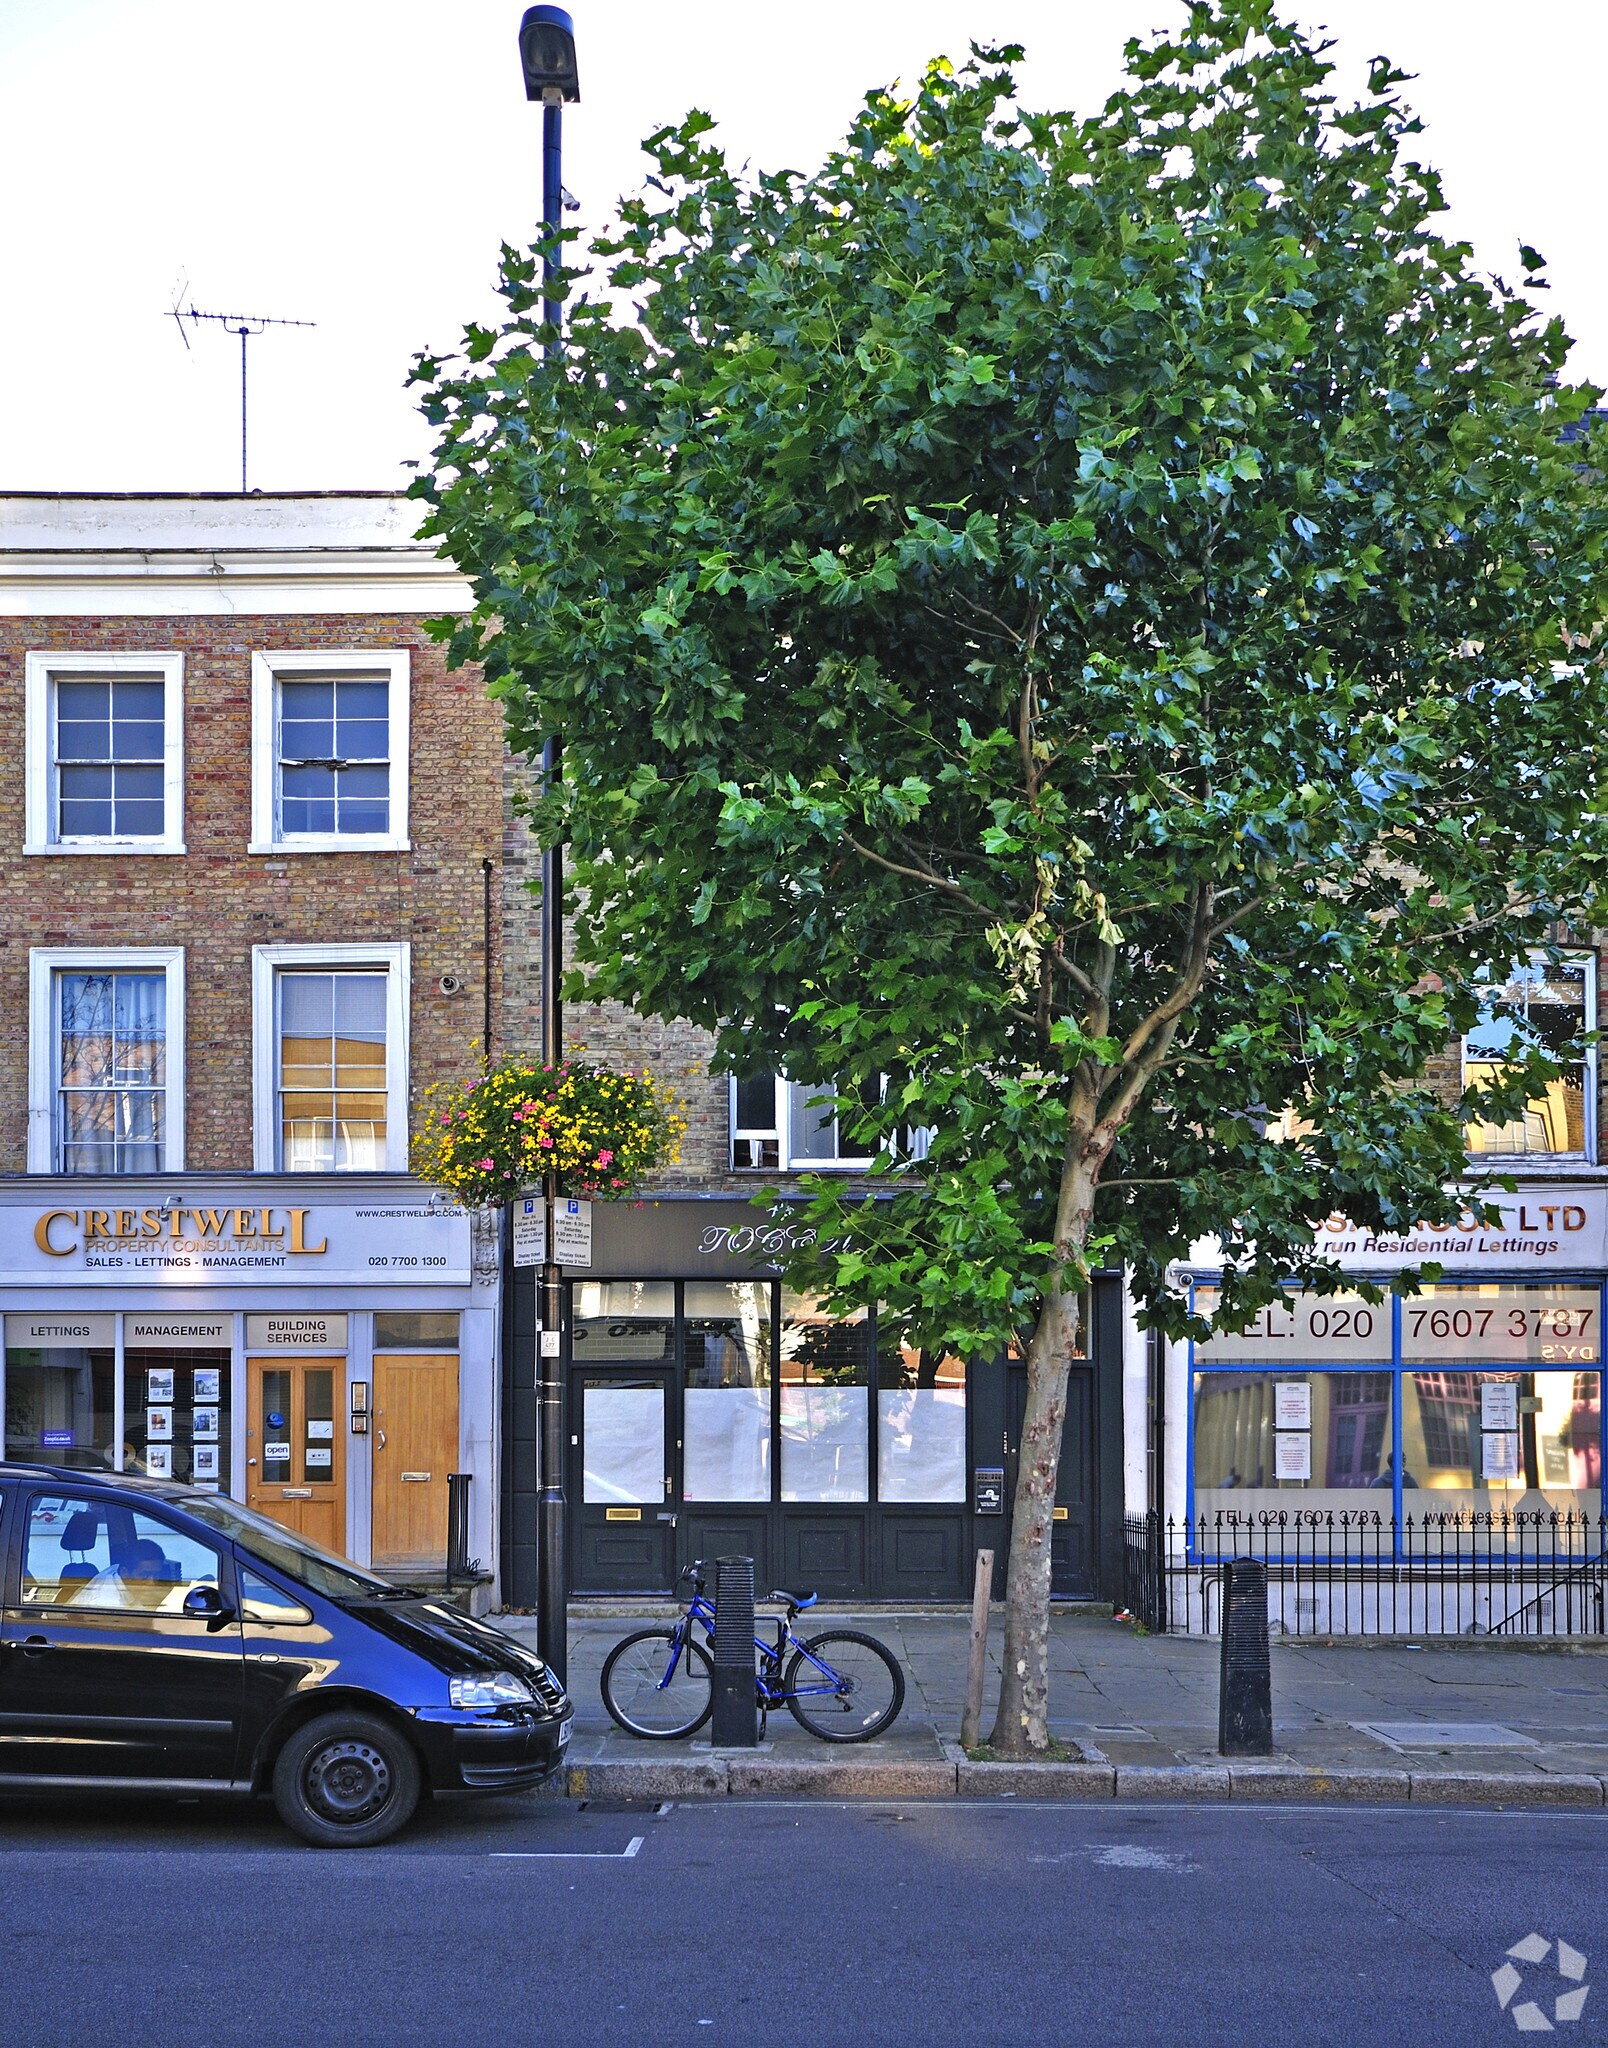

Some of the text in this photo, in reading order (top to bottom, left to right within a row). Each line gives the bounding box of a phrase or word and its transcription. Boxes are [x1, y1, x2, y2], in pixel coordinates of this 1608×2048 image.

[355, 1210, 462, 1218] WWW.CRESTWELLC.COM
[1519, 1206, 1587, 1231] LTD
[33, 1208, 328, 1256] CRESTWELL
[84, 1240, 285, 1253] PROPERTY CONSULTANTS
[1323, 1240, 1356, 1253] run
[1363, 1237, 1473, 1253] Residential
[1478, 1237, 1559, 1256] Lettings
[86, 1257, 123, 1267] SALES
[134, 1257, 191, 1267] LETTINGS
[202, 1257, 287, 1267] MANAGEMENT
[368, 1256, 447, 1266] 020 7700 1300
[268, 1321, 326, 1331] BUILDING
[1222, 1309, 1374, 1338] EL: 020
[1408, 1309, 1494, 1338] 7607
[1508, 1309, 1594, 1338] 3787
[30, 1326, 90, 1336] LETTINGS
[134, 1326, 223, 1336] MANAGEMENT
[267, 1333, 328, 1343] SERVICES
[266, 1446, 289, 1455] open
[1258, 1509, 1288, 1524] 020
[1293, 1509, 1334, 1524] 7607
[1339, 1509, 1379, 1524] 3787
[1424, 1508, 1586, 1524] wwwchessabrook.couk
